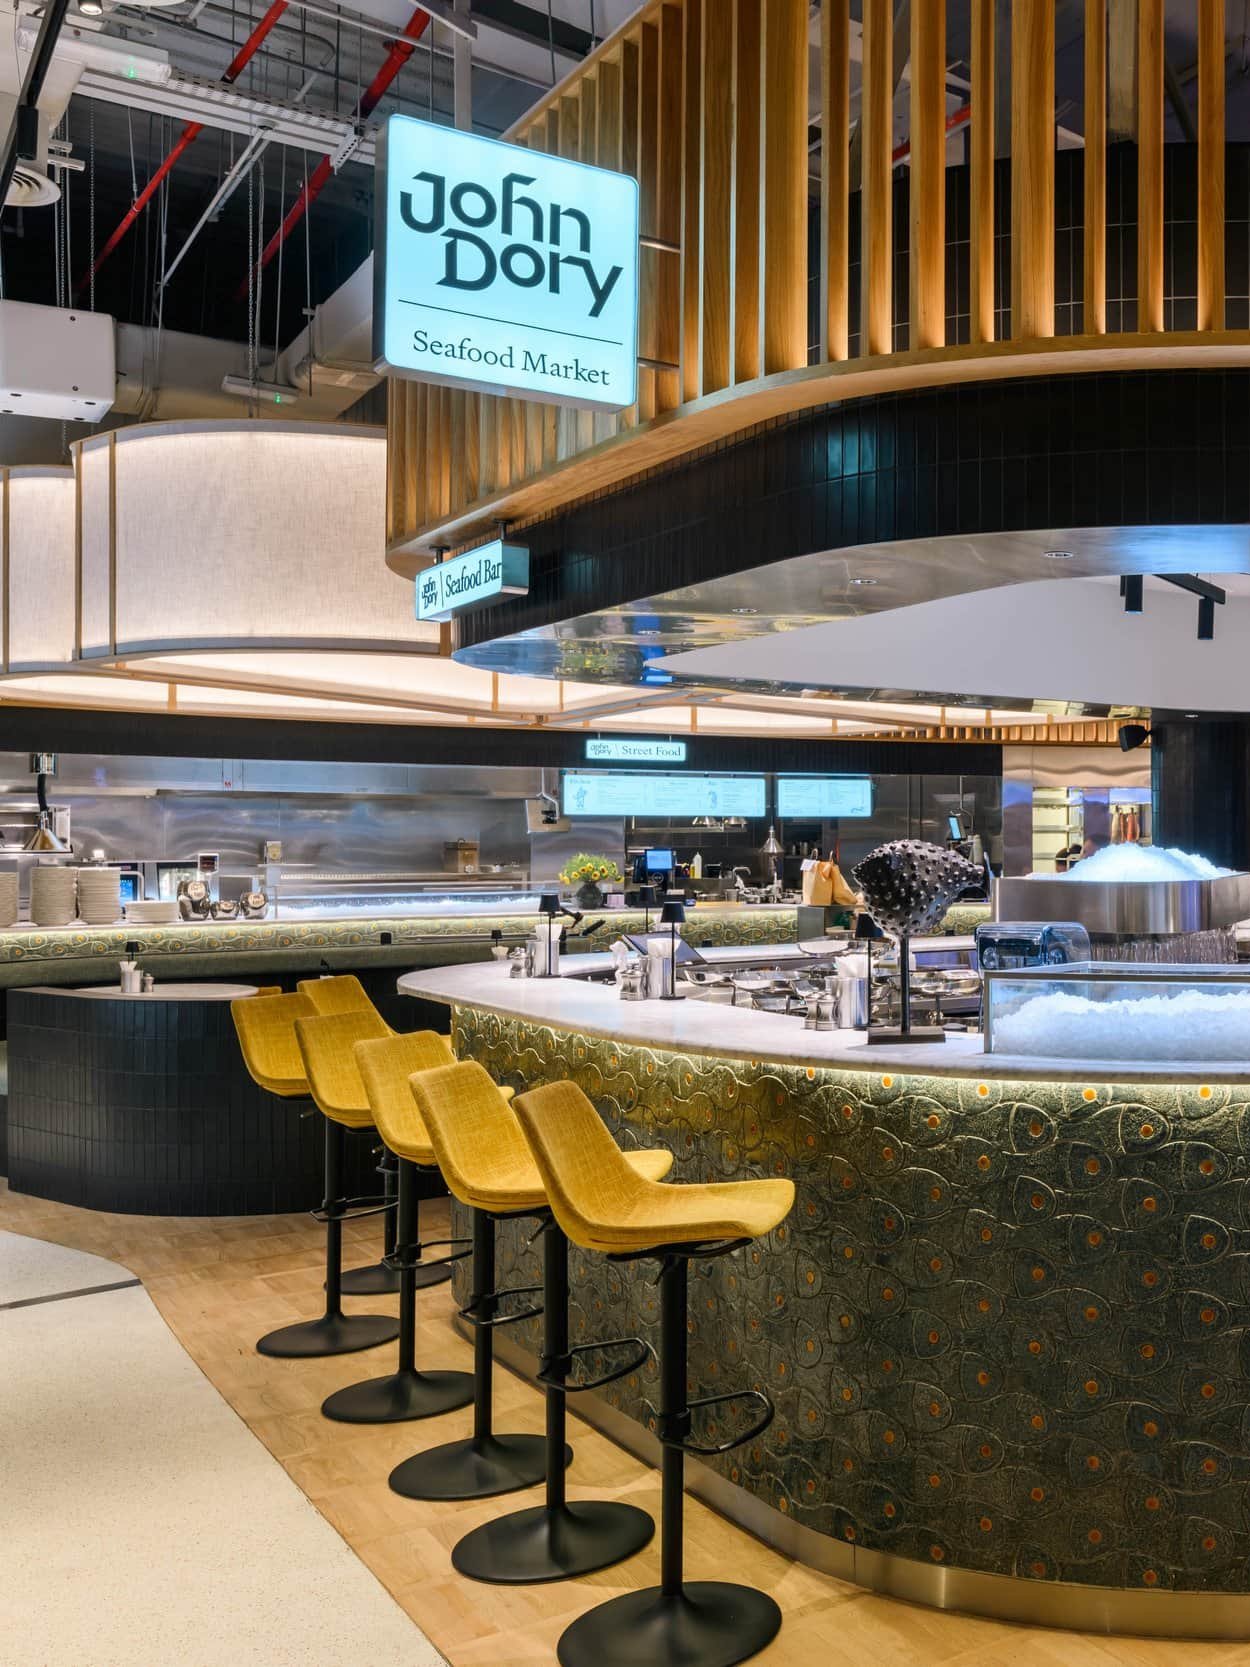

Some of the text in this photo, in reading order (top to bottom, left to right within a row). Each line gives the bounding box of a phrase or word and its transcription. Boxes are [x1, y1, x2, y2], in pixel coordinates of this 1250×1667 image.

[400, 171, 590, 253] John
[436, 228, 624, 318] Dory
[413, 330, 610, 386] Seafood Market
[445, 559, 502, 598] Seafood Bar
[622, 745, 681, 757] Street Food
